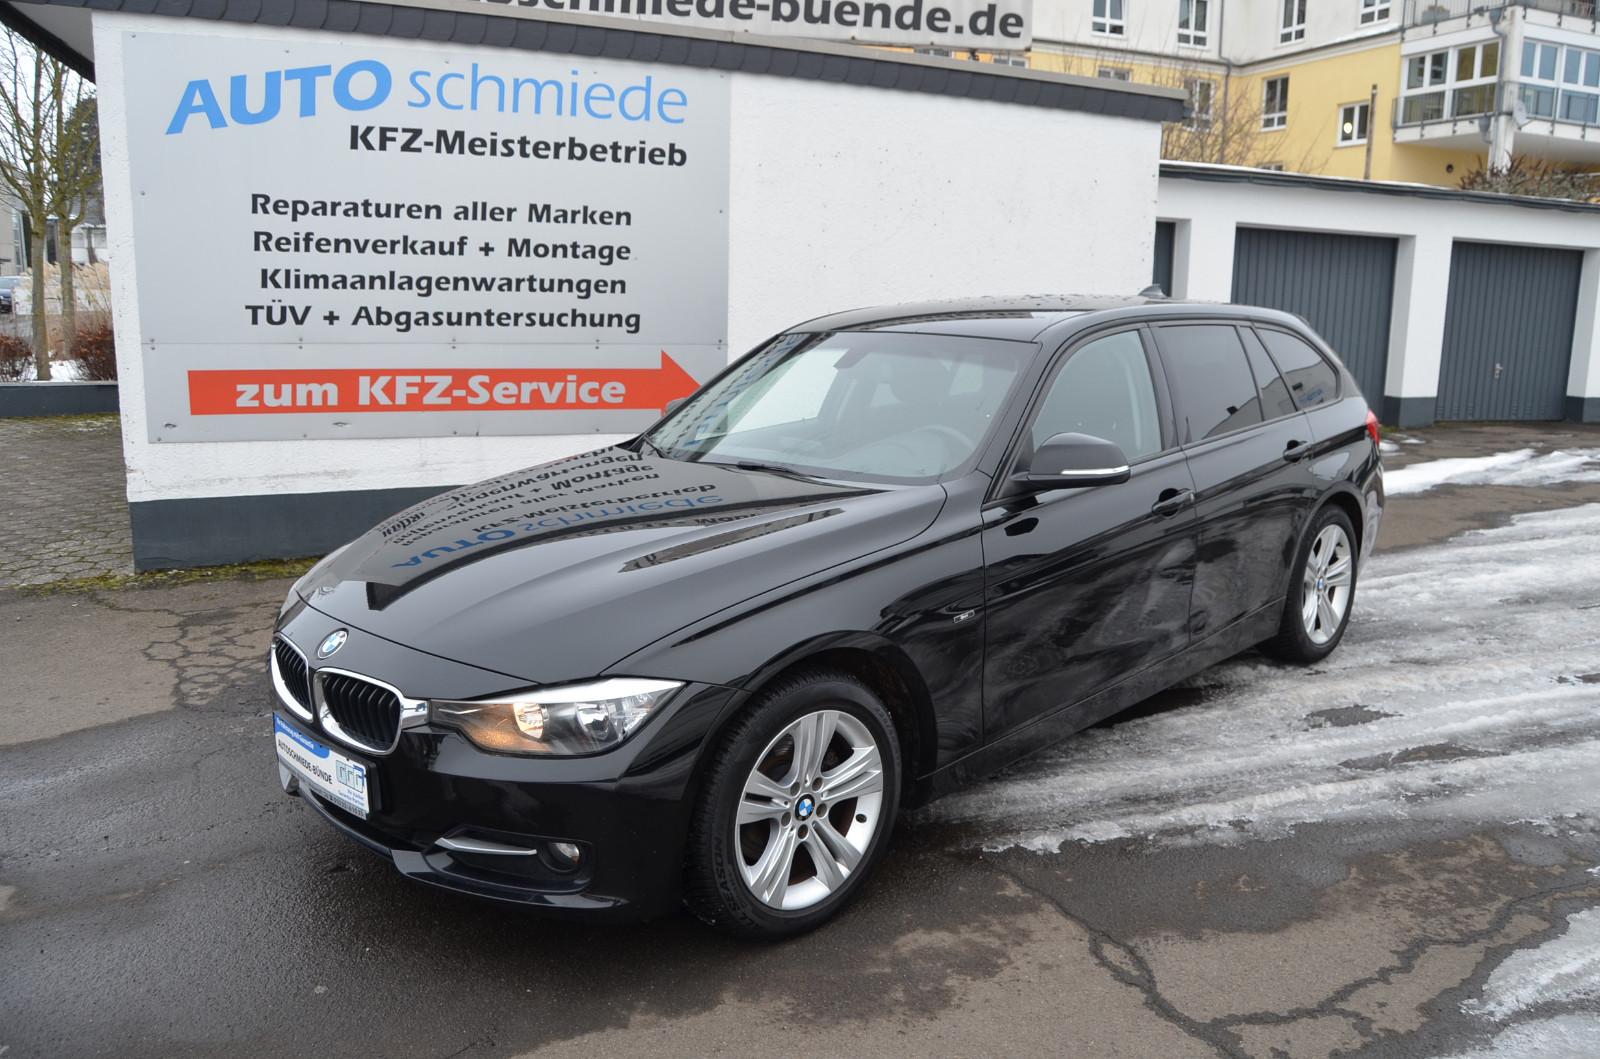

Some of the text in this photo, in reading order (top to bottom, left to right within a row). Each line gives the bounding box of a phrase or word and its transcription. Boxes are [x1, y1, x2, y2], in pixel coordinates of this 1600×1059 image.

[165, 59, 688, 136] AUTO schmiede
[350, 126, 687, 167] KFZ-Meisterbetrieb
[252, 194, 632, 227] Reparaturen aller Marken
[253, 231, 631, 265] Reifenverkauf + Montage
[260, 268, 627, 298] Klimaanlagenwartungen
[245, 300, 641, 333] TÜV + Abgasuntersuchung
[236, 375, 626, 408] zum KFZ-Service
